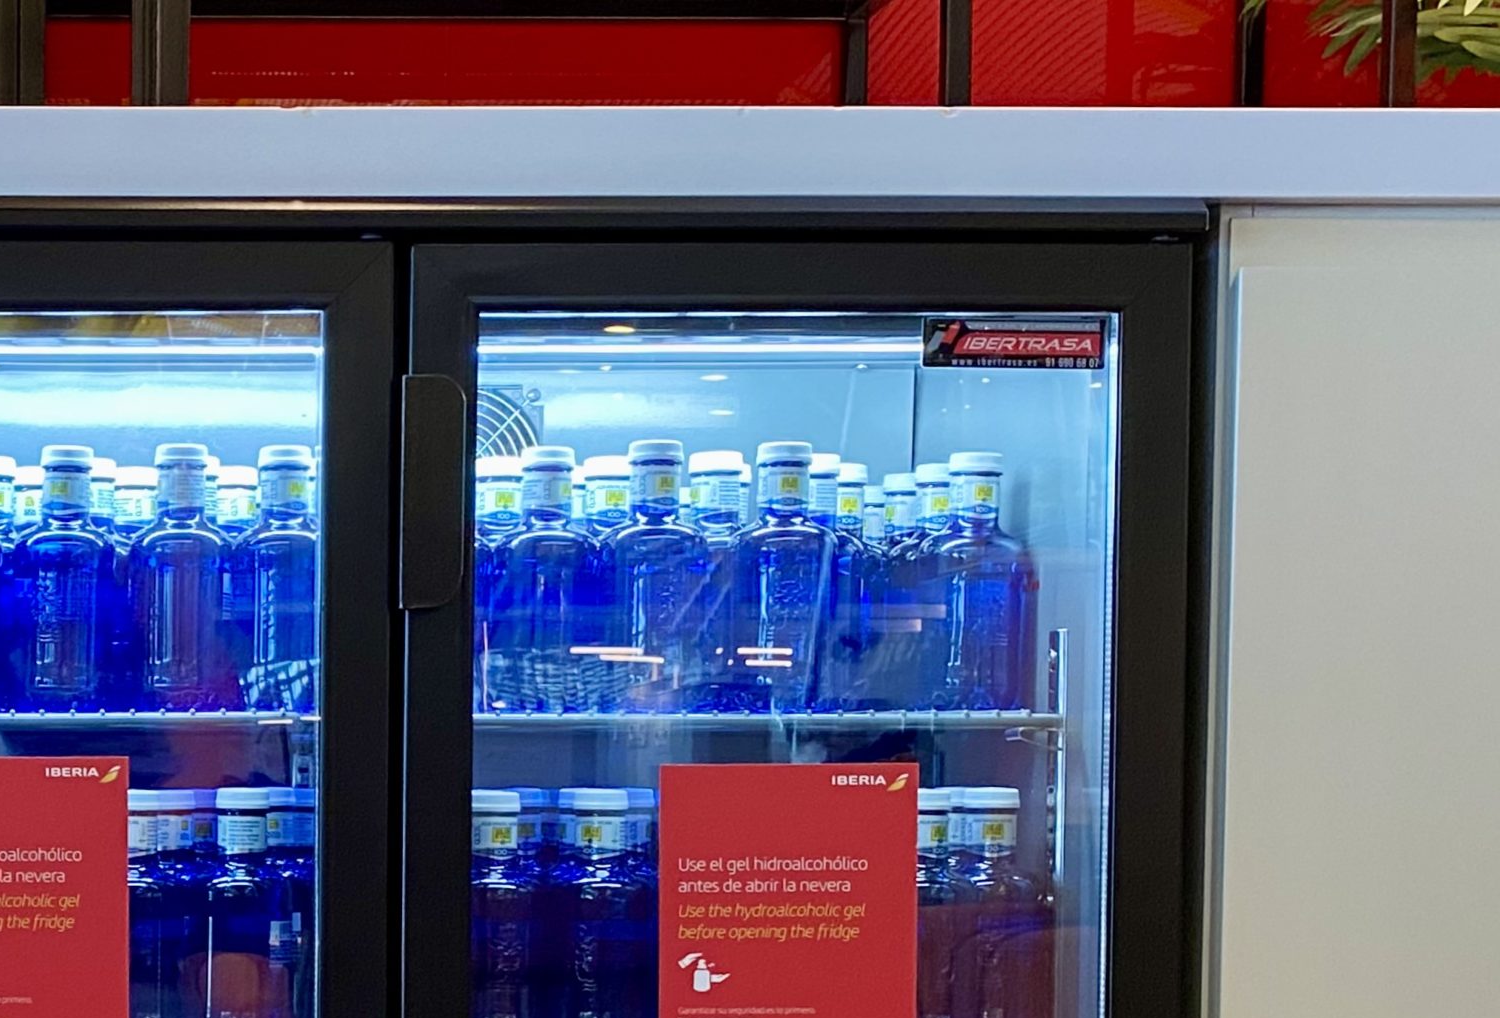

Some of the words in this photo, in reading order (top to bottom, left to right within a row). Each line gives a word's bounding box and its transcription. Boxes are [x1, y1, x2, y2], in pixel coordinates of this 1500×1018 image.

[963, 336, 1093, 351] IBERTRASA
[45, 767, 99, 777] IBERIA
[831, 774, 887, 785] IBERIA
[678, 858, 706, 872] Use
[710, 857, 723, 872] el
[726, 857, 751, 876] gel
[754, 856, 869, 872] hidroalcohólico
[0, 868, 12, 884] la
[16, 871, 66, 884] nevera
[678, 880, 720, 893] antes
[723, 878, 742, 893] de
[745, 878, 779, 893] abrir
[783, 878, 796, 893] la
[800, 881, 852, 893] nevera
[58, 894, 81, 911] gel
[678, 904, 706, 918] Use
[709, 904, 733, 918] the
[735, 903, 841, 920] hydroalcoholic
[844, 904, 866, 921] gel
[7, 914, 31, 929] the
[33, 914, 76, 932] fridge
[679, 924, 726, 940] before
[729, 927, 788, 942] opening
[791, 924, 815, 939] the
[817, 923, 861, 941] fridge
